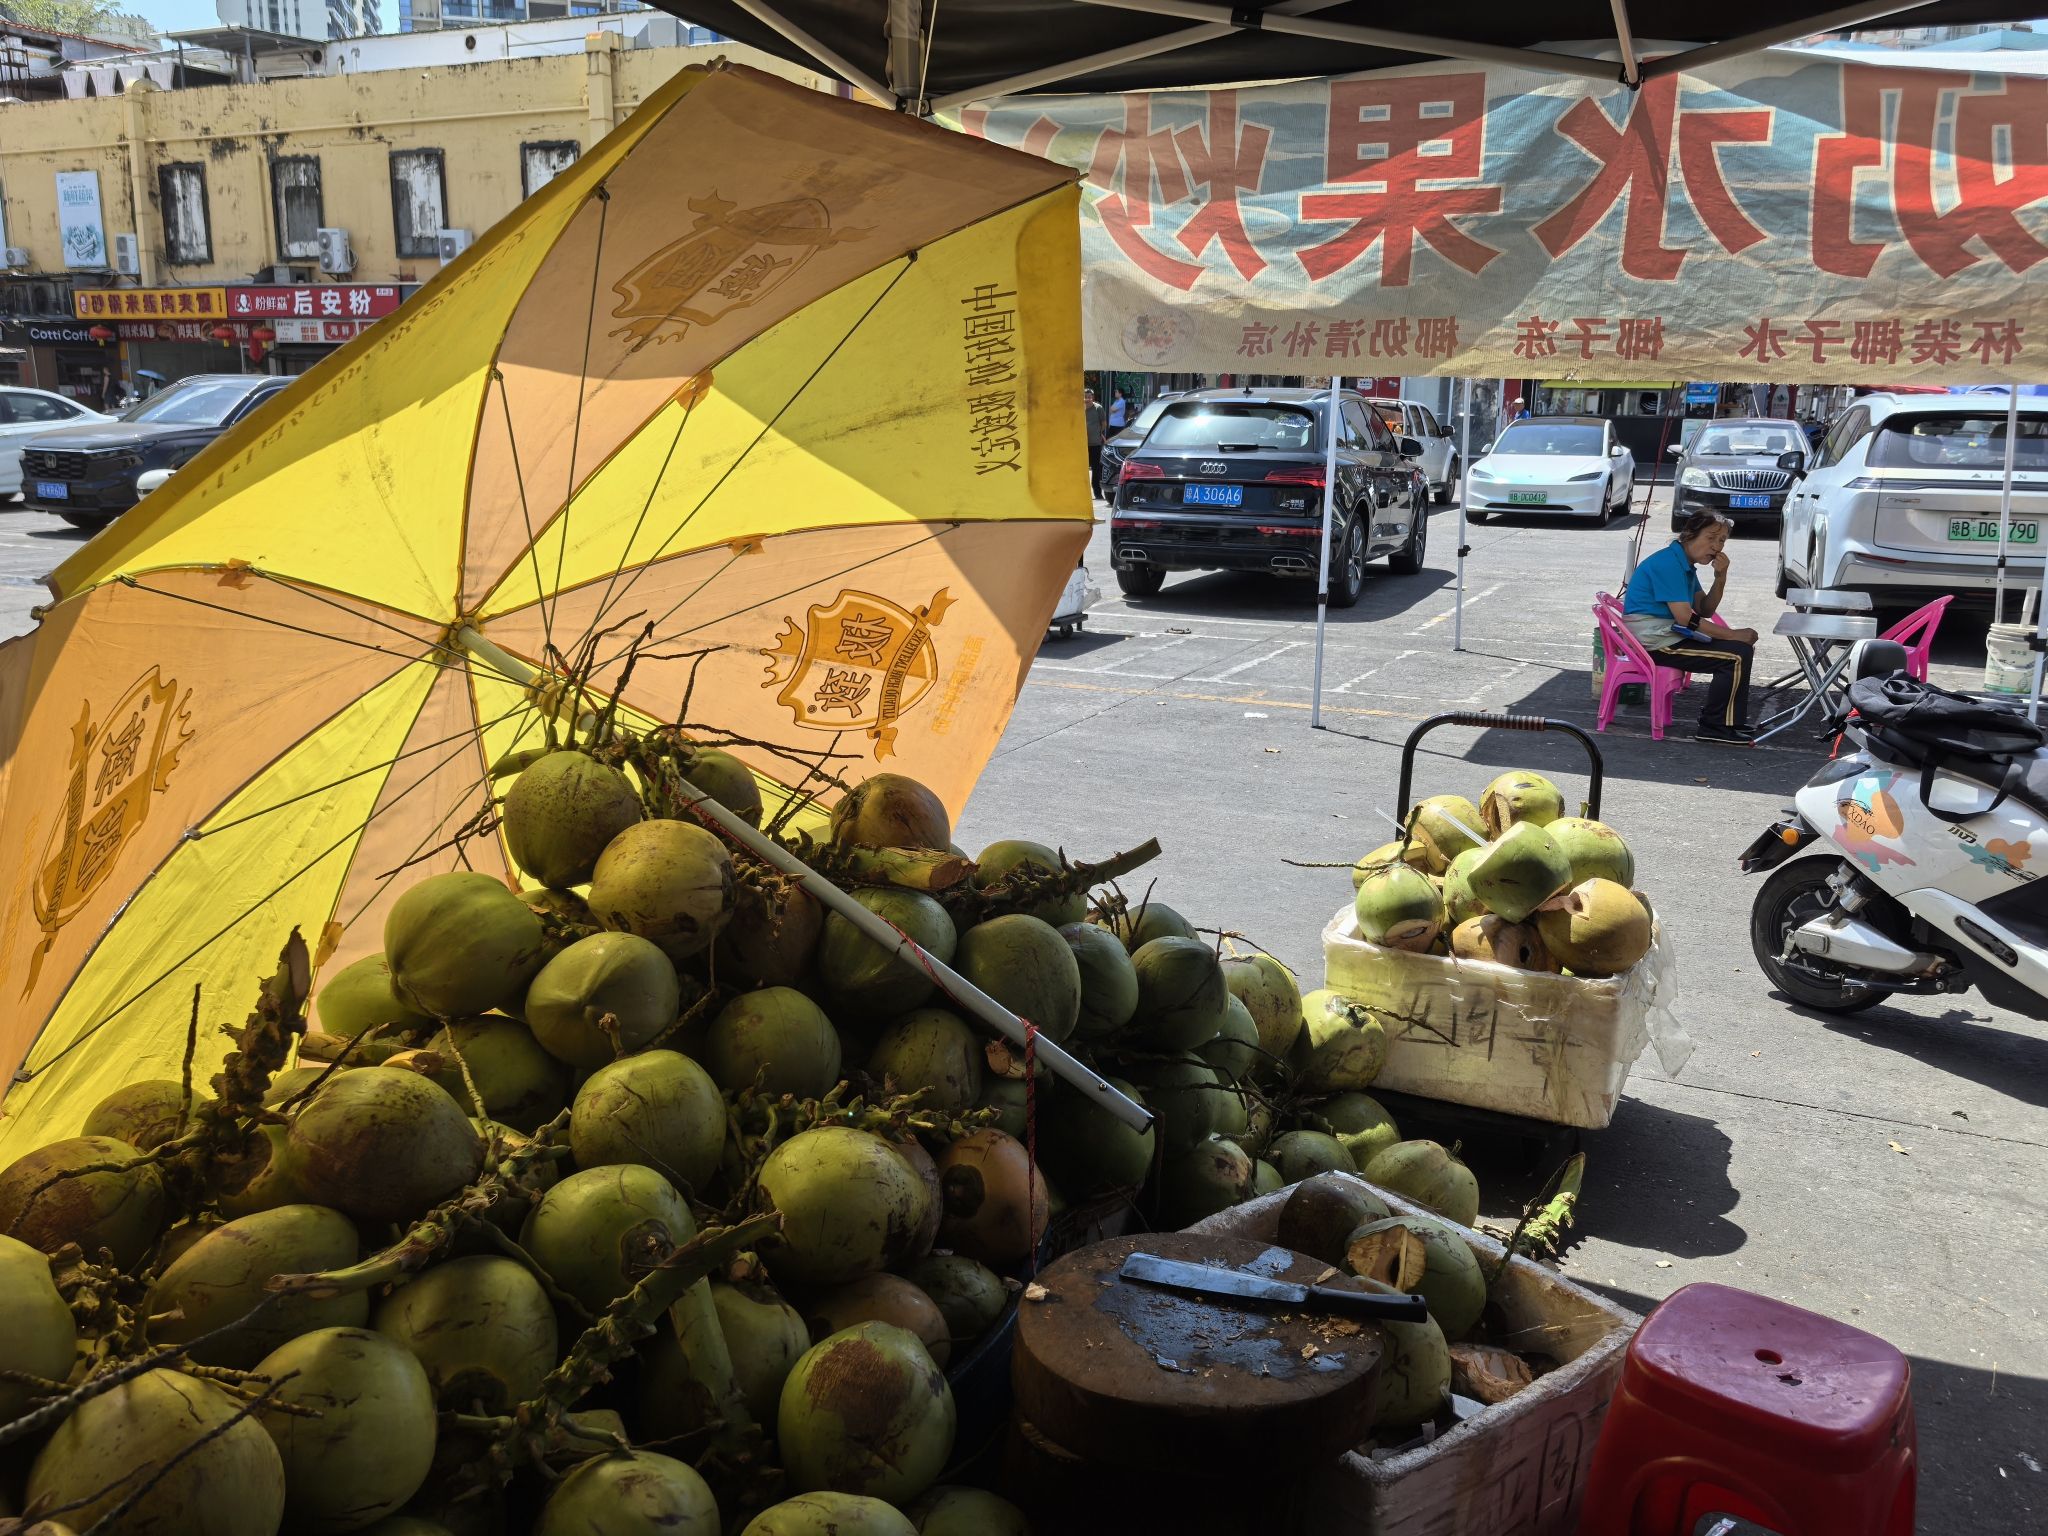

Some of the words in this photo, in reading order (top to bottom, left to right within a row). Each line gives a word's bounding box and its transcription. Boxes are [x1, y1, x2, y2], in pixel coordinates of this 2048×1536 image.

[294, 289, 371, 315] 后安粉
[30, 327, 60, 340] Cotti
